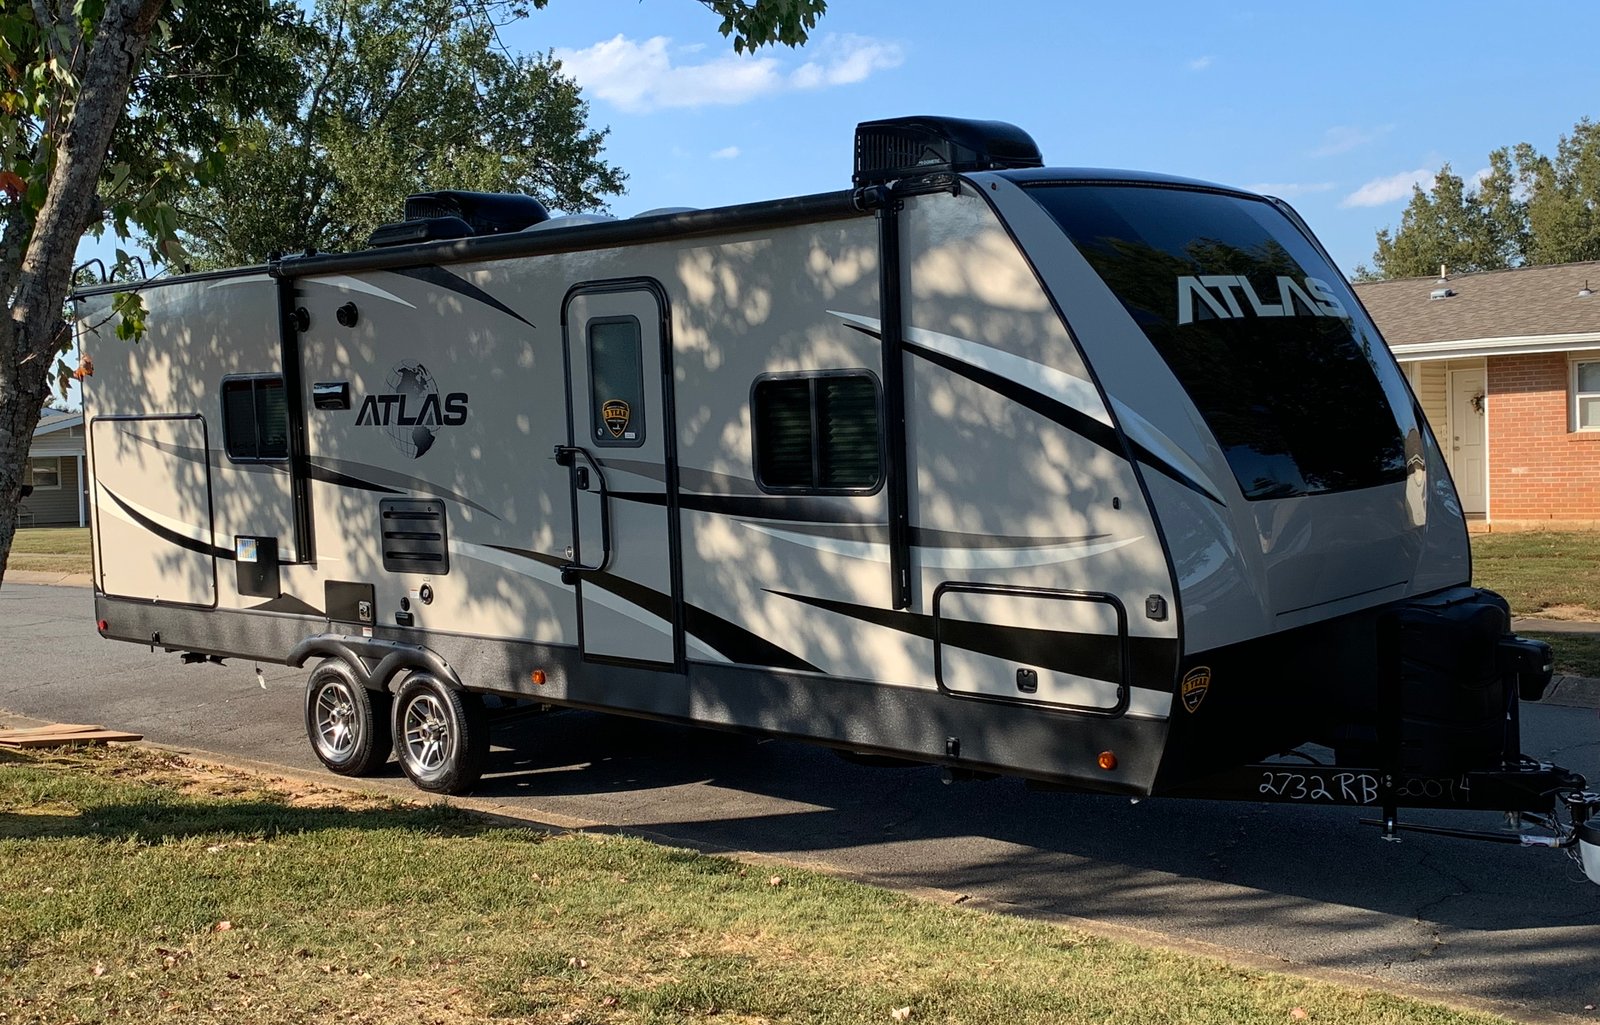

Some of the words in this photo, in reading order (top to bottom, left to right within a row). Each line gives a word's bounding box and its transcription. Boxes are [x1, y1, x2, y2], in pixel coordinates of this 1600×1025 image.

[1178, 275, 1349, 325] ATLAS
[355, 392, 468, 426] ATLAS
[610, 409, 627, 417] YEAR
